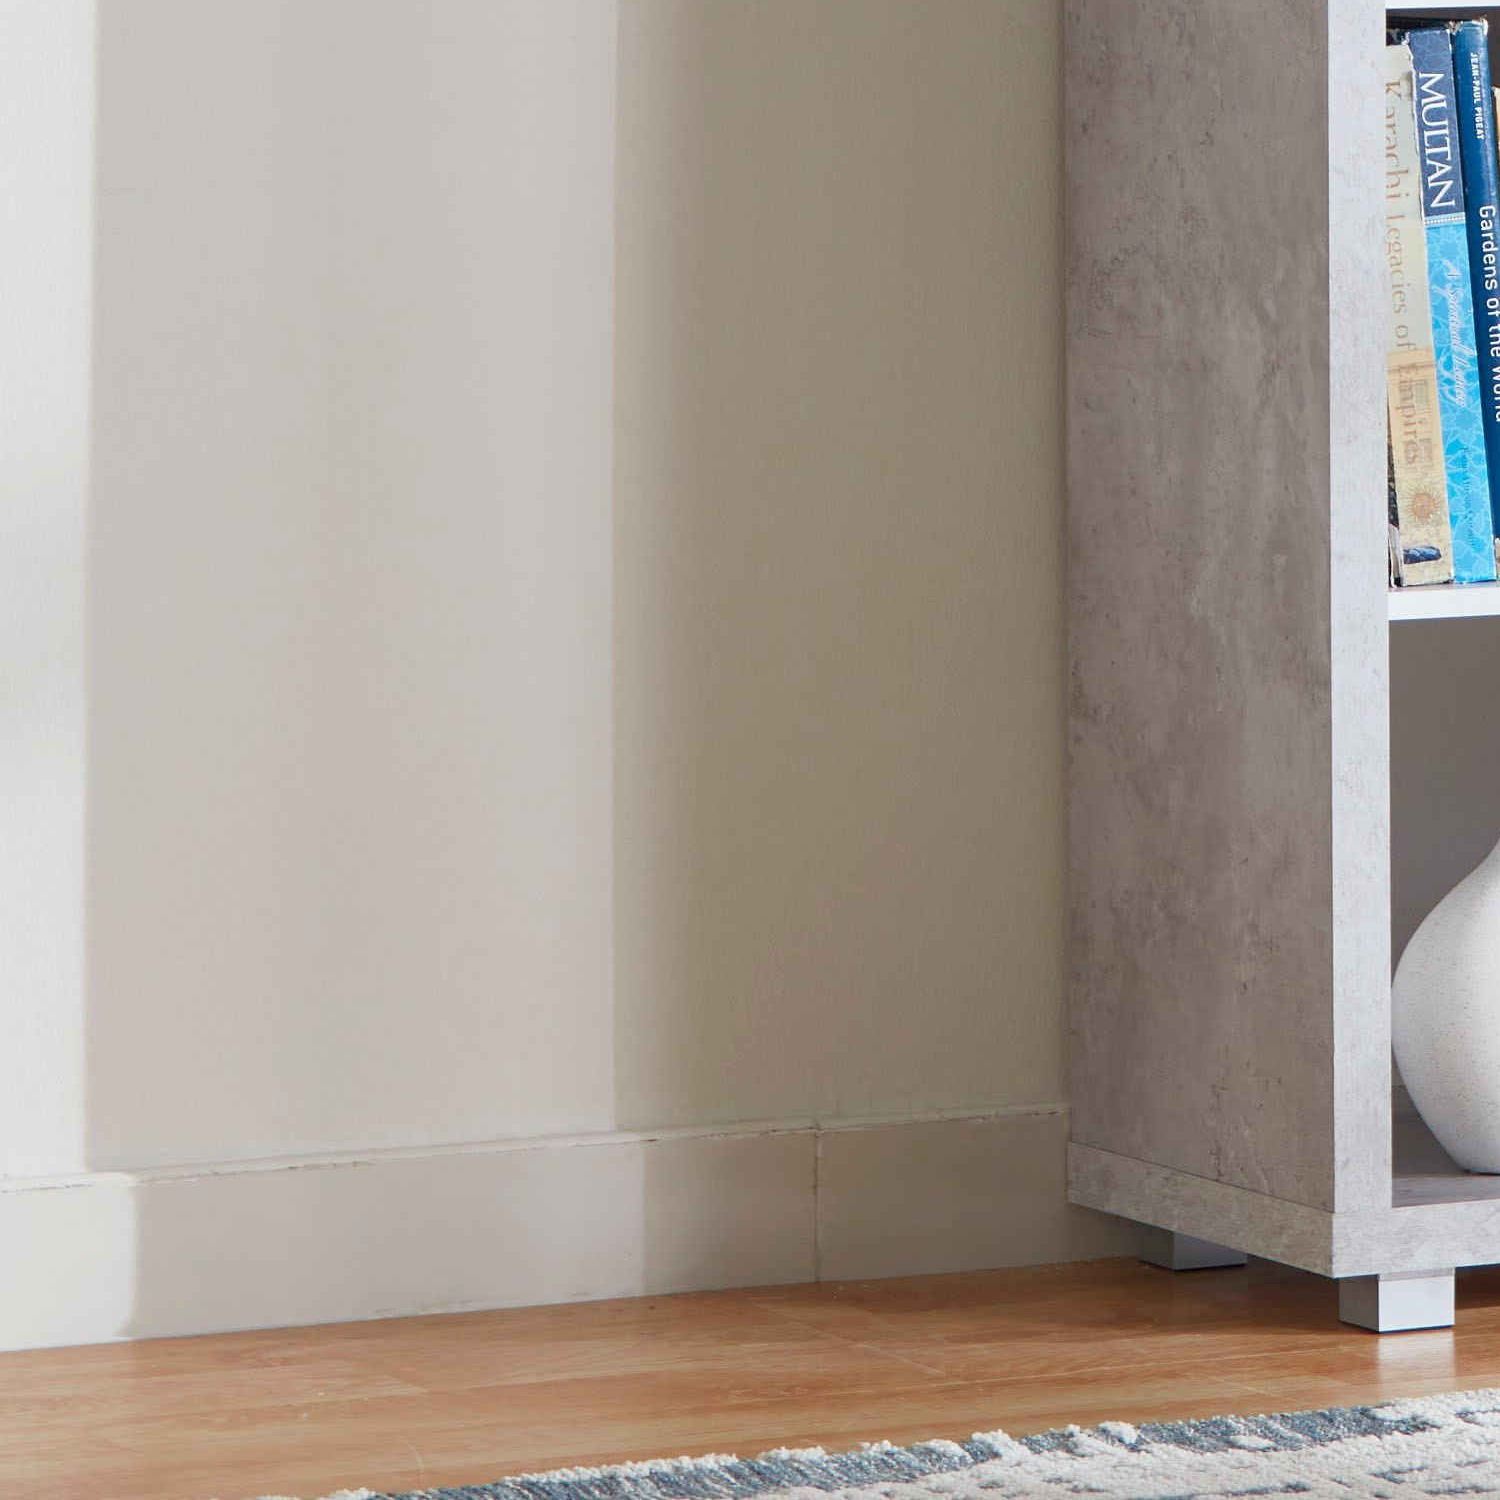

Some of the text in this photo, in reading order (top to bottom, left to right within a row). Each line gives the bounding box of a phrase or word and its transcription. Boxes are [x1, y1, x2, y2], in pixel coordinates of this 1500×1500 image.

[1419, 72, 1456, 208] MULTAN
[1470, 52, 1485, 140] JEAN-PAUL PIGEAT
[1386, 213, 1410, 314] Legacies
[1479, 204, 1499, 290] Gardens
[1394, 324, 1416, 350] of
[1396, 364, 1425, 465] Empires
